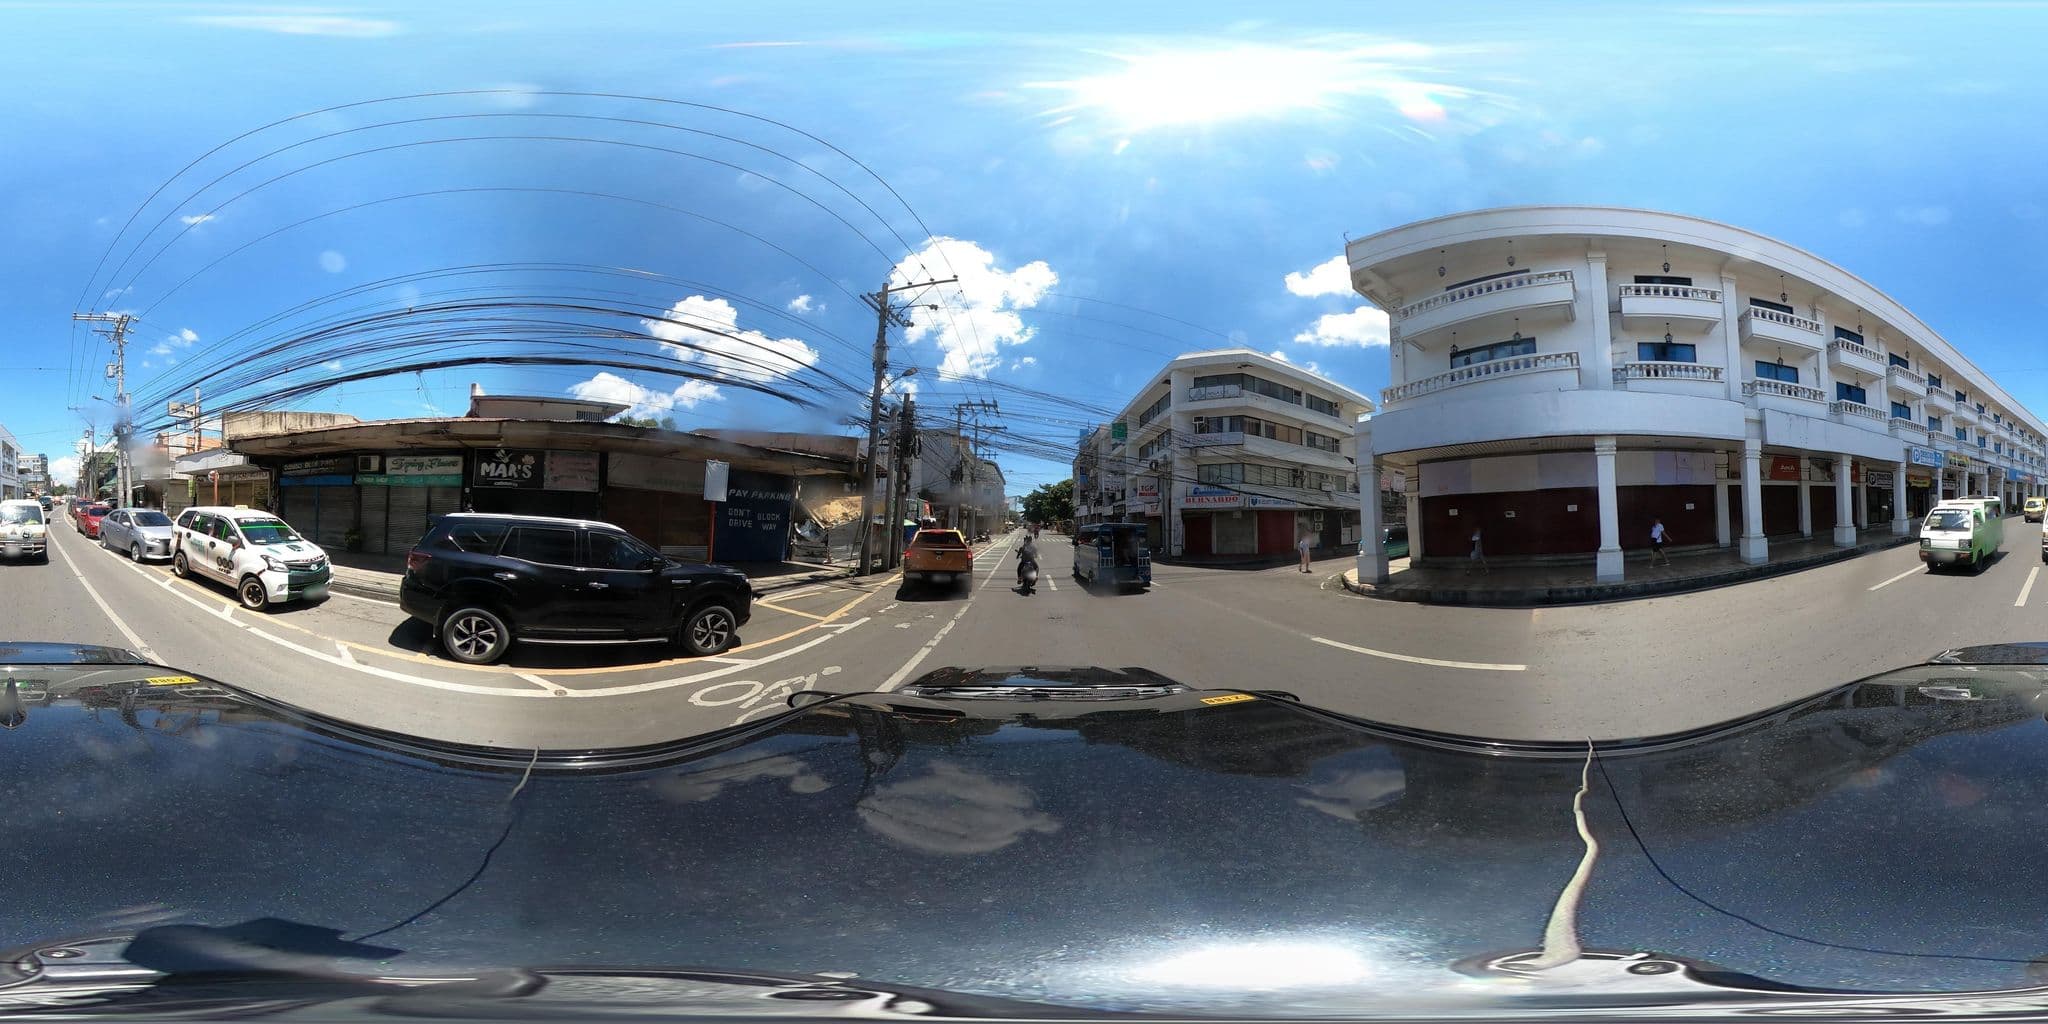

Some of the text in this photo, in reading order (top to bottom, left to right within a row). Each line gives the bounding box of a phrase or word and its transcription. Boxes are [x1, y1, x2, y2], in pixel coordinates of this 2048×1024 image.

[480, 462, 533, 478] MAR'S
[728, 488, 792, 501] PAY PARKING
[1185, 495, 1239, 504] BERNARDO
[728, 518, 778, 531] DRIVE WAY
